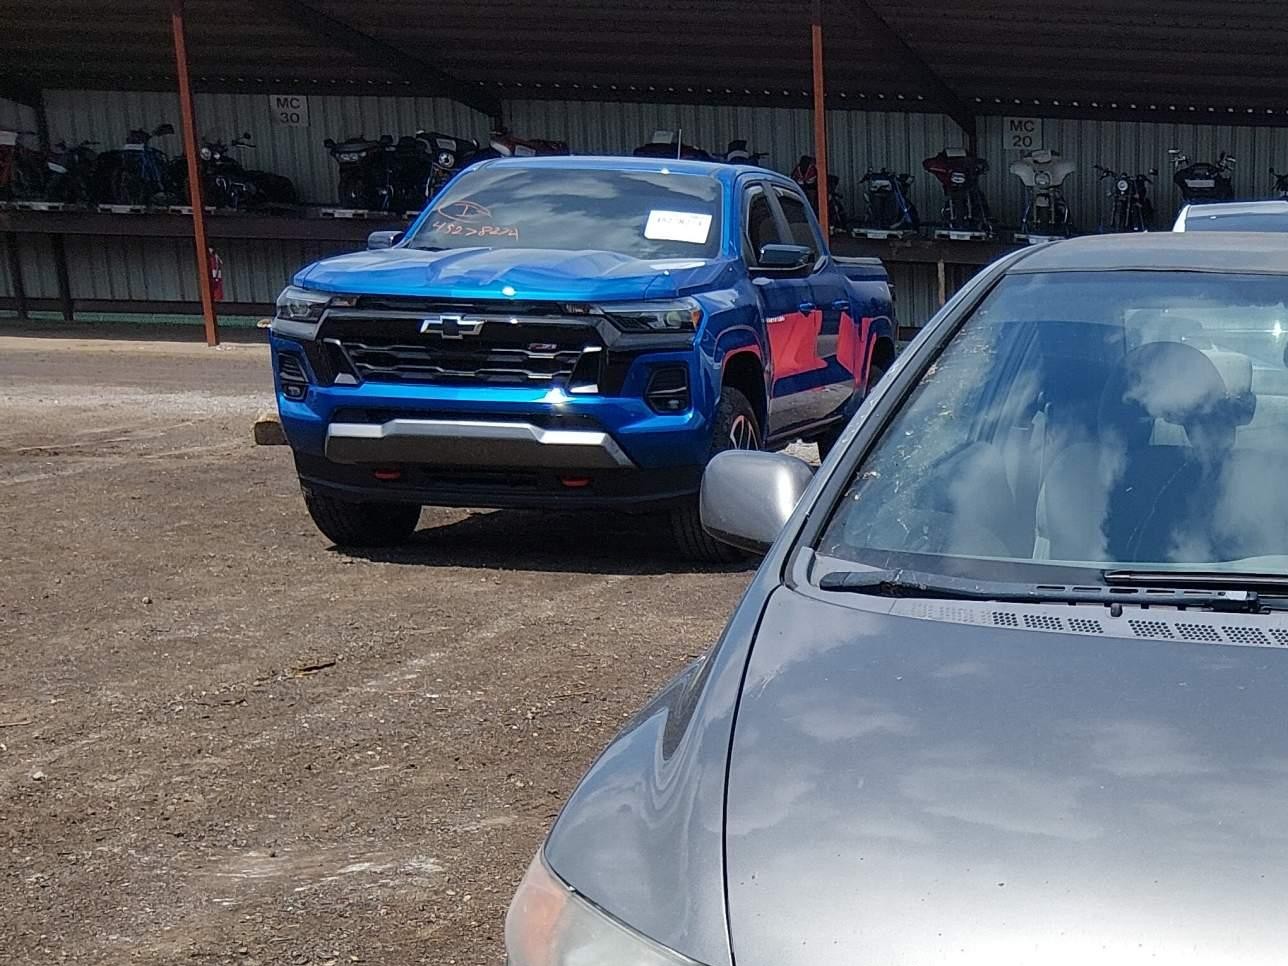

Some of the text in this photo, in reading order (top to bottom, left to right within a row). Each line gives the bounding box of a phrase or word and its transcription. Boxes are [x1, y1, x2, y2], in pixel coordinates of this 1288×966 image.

[276, 96, 301, 109] MC
[279, 112, 300, 124] 30
[1009, 119, 1035, 132] MC
[1012, 135, 1033, 148] 20
